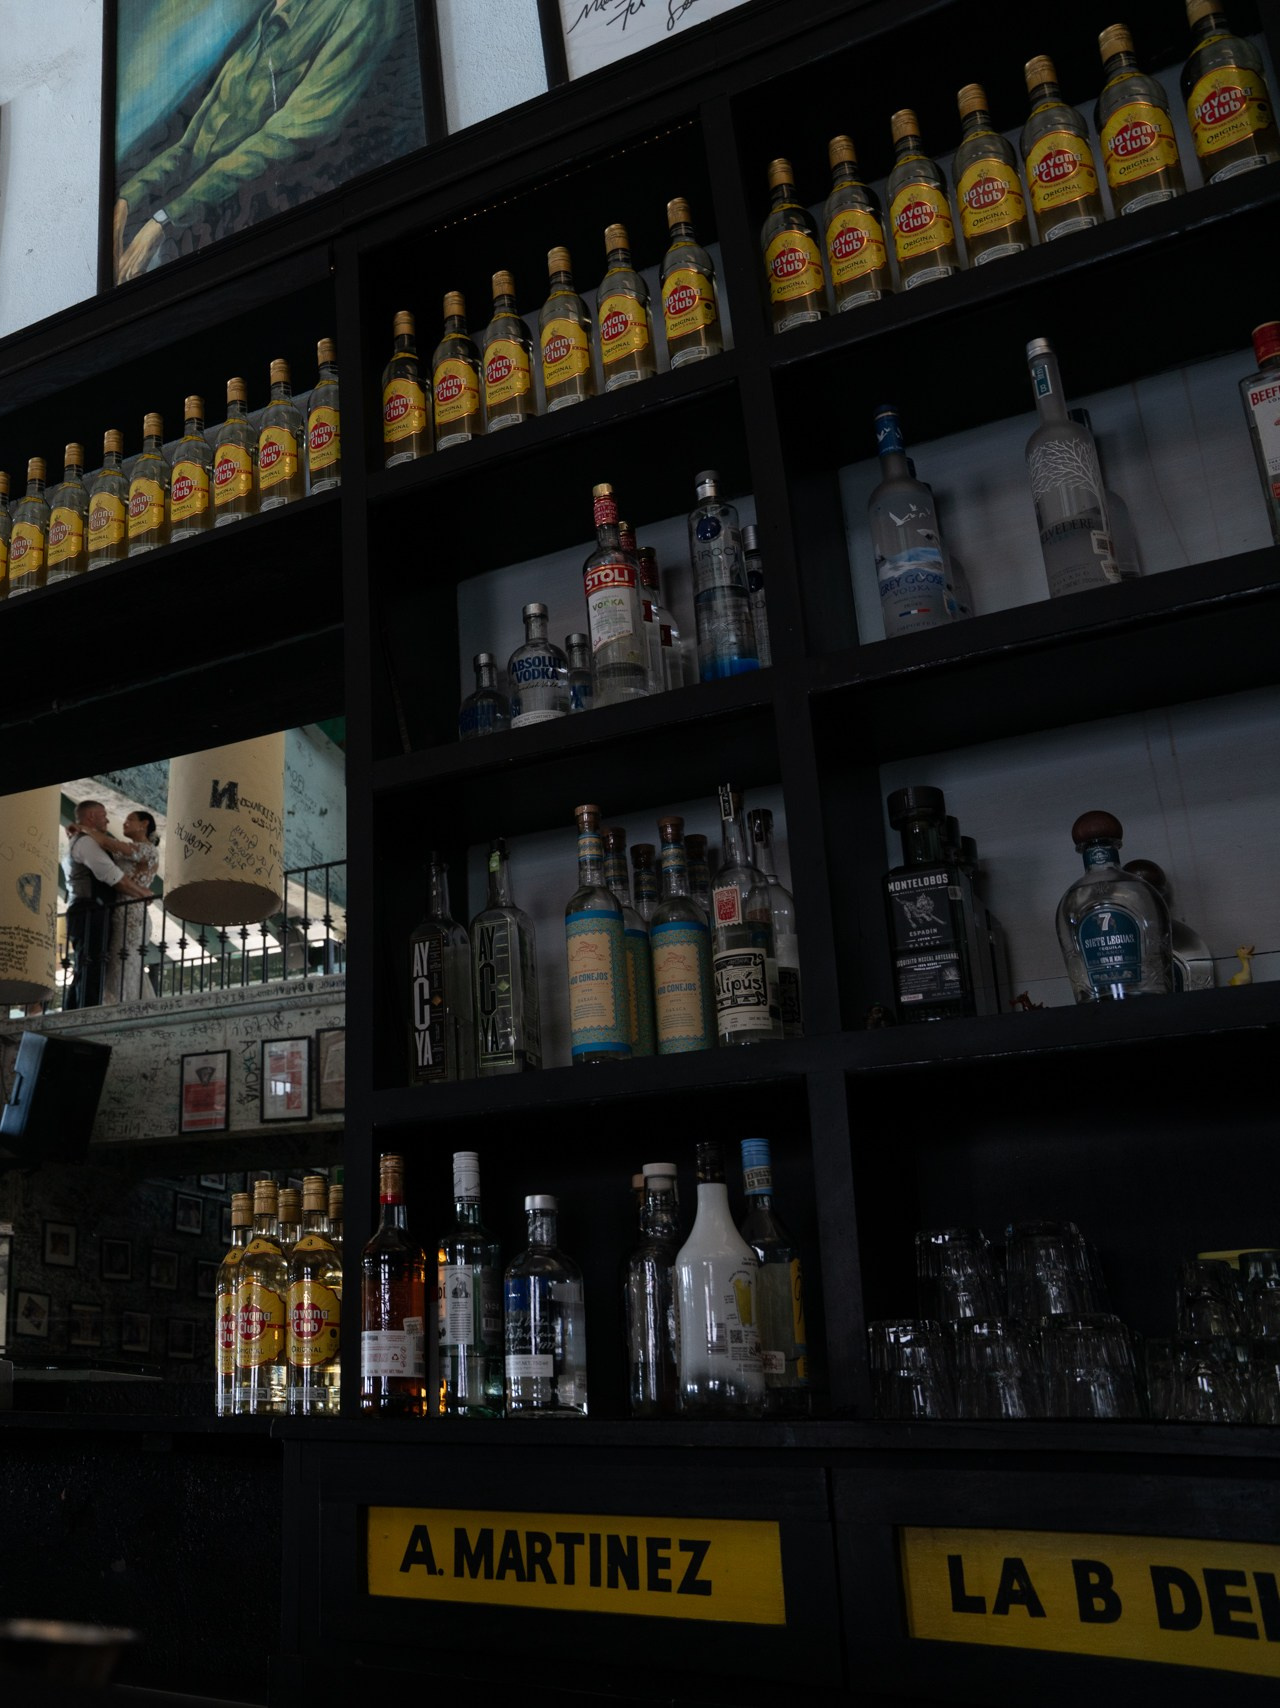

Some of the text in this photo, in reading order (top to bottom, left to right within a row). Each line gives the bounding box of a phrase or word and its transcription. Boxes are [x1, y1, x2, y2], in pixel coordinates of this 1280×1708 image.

[1194, 87, 1252, 119] Havana
[1205, 101, 1241, 124] Club
[1108, 123, 1161, 150] Havana
[1206, 122, 1250, 144] ORIGINAL
[1118, 136, 1151, 155] Club
[1033, 152, 1081, 176] Havana
[1119, 155, 1160, 175] ORIGINAL
[1042, 165, 1073, 182] Club
[963, 181, 1010, 203] Havana
[972, 191, 1002, 208] Club
[1043, 184, 1081, 201] ORIGINAL
[894, 201, 938, 225] Havana
[972, 211, 1010, 227] ORIGINAL
[902, 214, 930, 232] Club
[830, 228, 869, 252] Havana
[836, 241, 861, 258] Club
[770, 247, 810, 271] Havana
[776, 261, 803, 277] Club
[670, 297, 693, 314] Club
[604, 324, 625, 340] Club
[546, 347, 568, 363] Club
[488, 367, 509, 382] Club
[438, 387, 459, 401] Club
[385, 405, 405, 421] Club
[310, 434, 329, 449] Club
[260, 453, 277, 467] Club
[216, 471, 232, 485] Club
[173, 488, 190, 501] Club
[586, 569, 629, 590] STOLI
[880, 573, 944, 597] GREY GOOSE
[893, 586, 930, 597] VODKA
[592, 599, 624, 611] VODKA
[511, 656, 562, 675] ABSOLUT
[516, 668, 559, 683] VODKA
[888, 873, 949, 893] MONTELOBOS
[1098, 913, 1111, 931] 7
[1085, 936, 1106, 949] SIETE
[579, 973, 608, 983] CONEJOS
[667, 983, 696, 993] CONEJOS
[240, 1322, 261, 1334] Club
[294, 1320, 318, 1332] Club
[947, 1555, 1047, 1618] LA
[1072, 1559, 1122, 1624] B
